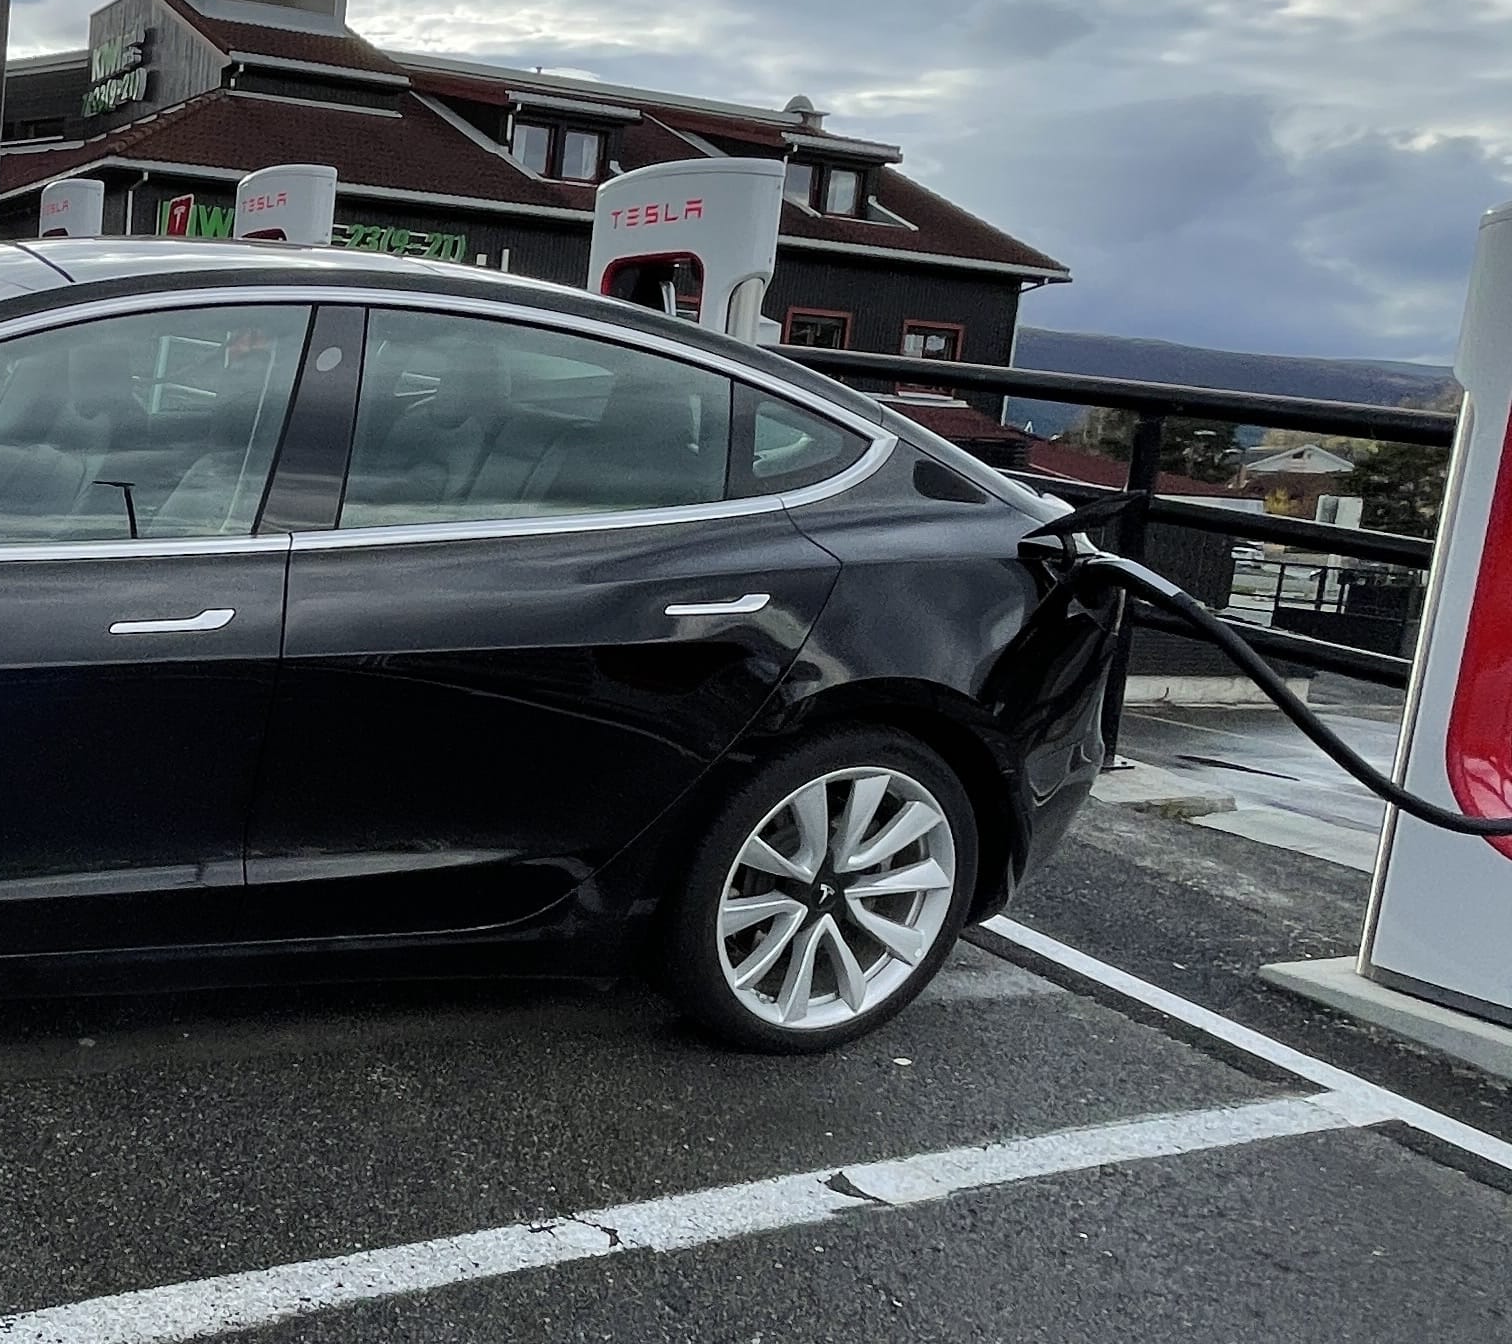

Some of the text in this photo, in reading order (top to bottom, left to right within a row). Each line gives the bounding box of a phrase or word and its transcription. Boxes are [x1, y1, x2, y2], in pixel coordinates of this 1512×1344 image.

[241, 191, 288, 214] TESLA
[610, 198, 703, 230] TESLA
[331, 223, 467, 263] -23(9-21)
